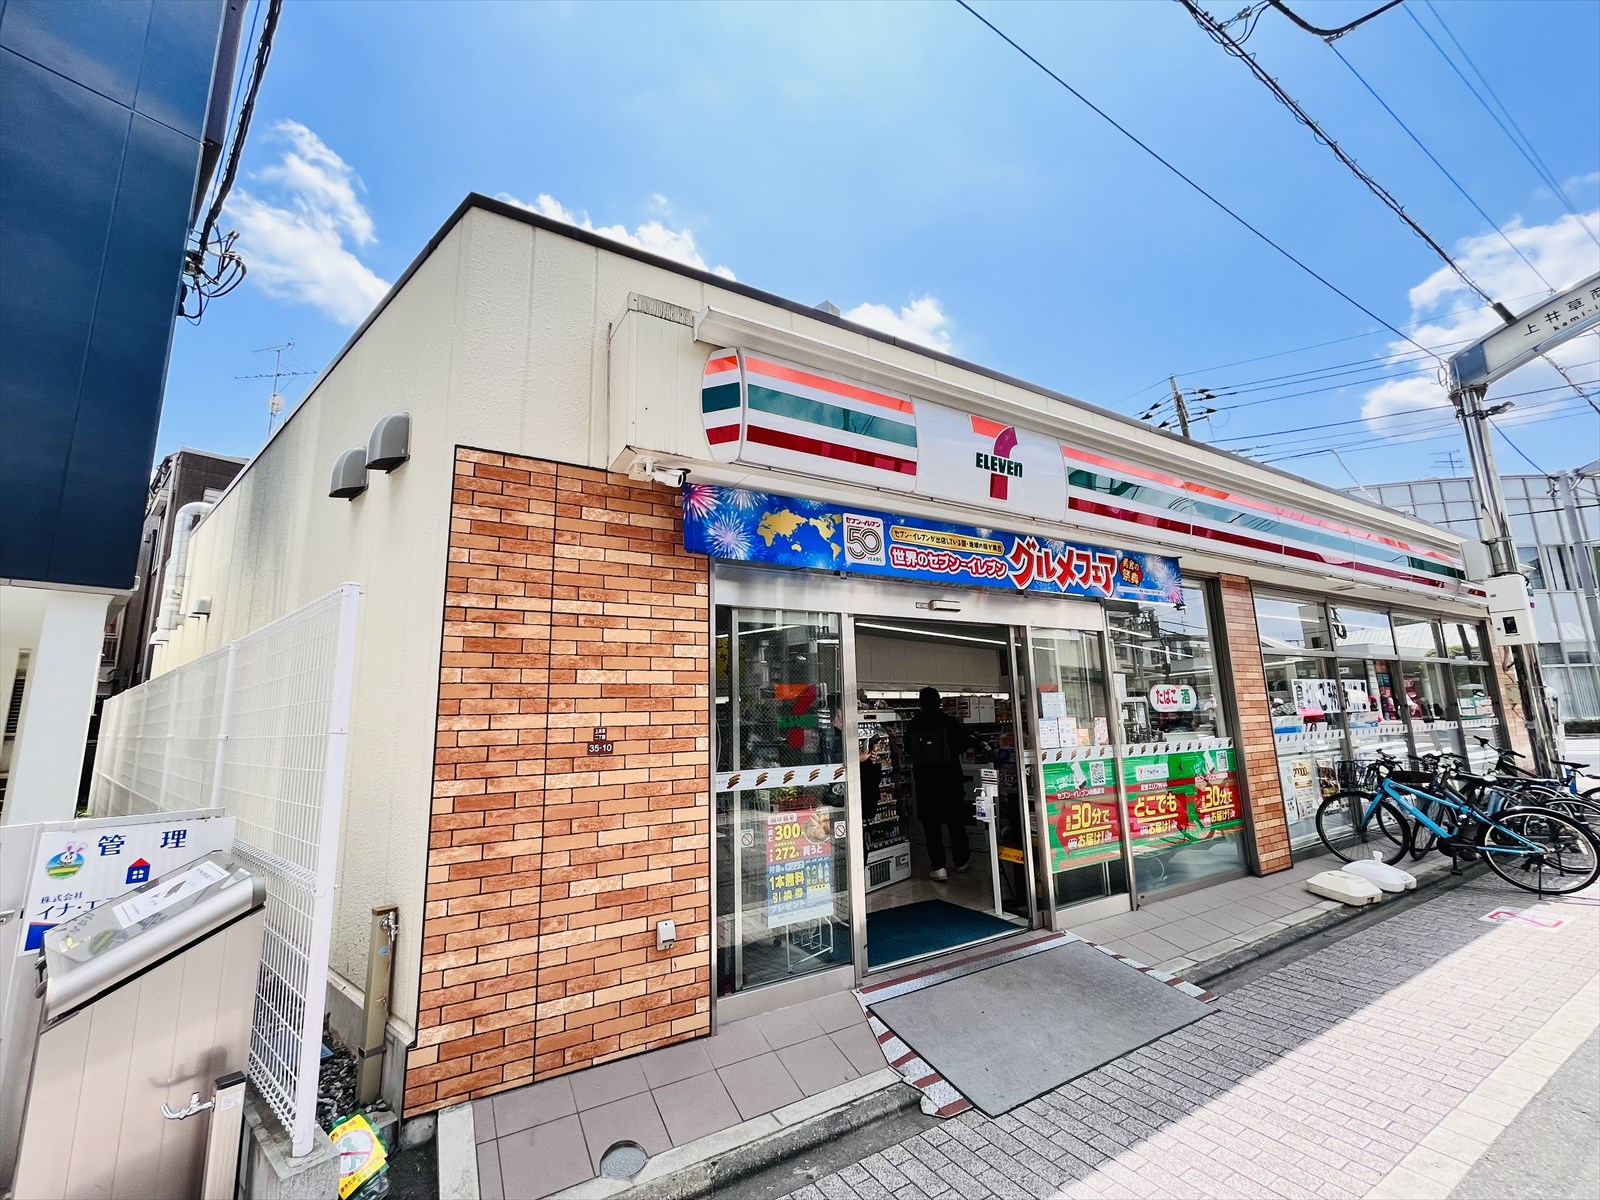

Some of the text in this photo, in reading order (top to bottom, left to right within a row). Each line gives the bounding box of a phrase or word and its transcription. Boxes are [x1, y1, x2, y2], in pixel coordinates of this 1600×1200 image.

[847, 525, 882, 560] 50
[1008, 538, 1117, 595] グルメフェア
[1155, 688, 1191, 705] たばこ 酒
[1133, 792, 1178, 818] どこでも
[1071, 802, 1110, 831] 30分で
[803, 844, 823, 857] 買うと
[769, 871, 804, 891] 1本無料
[41, 891, 83, 904] 株式会社
[772, 887, 804, 904] 引換券
[37, 897, 115, 920] イナ・エ
